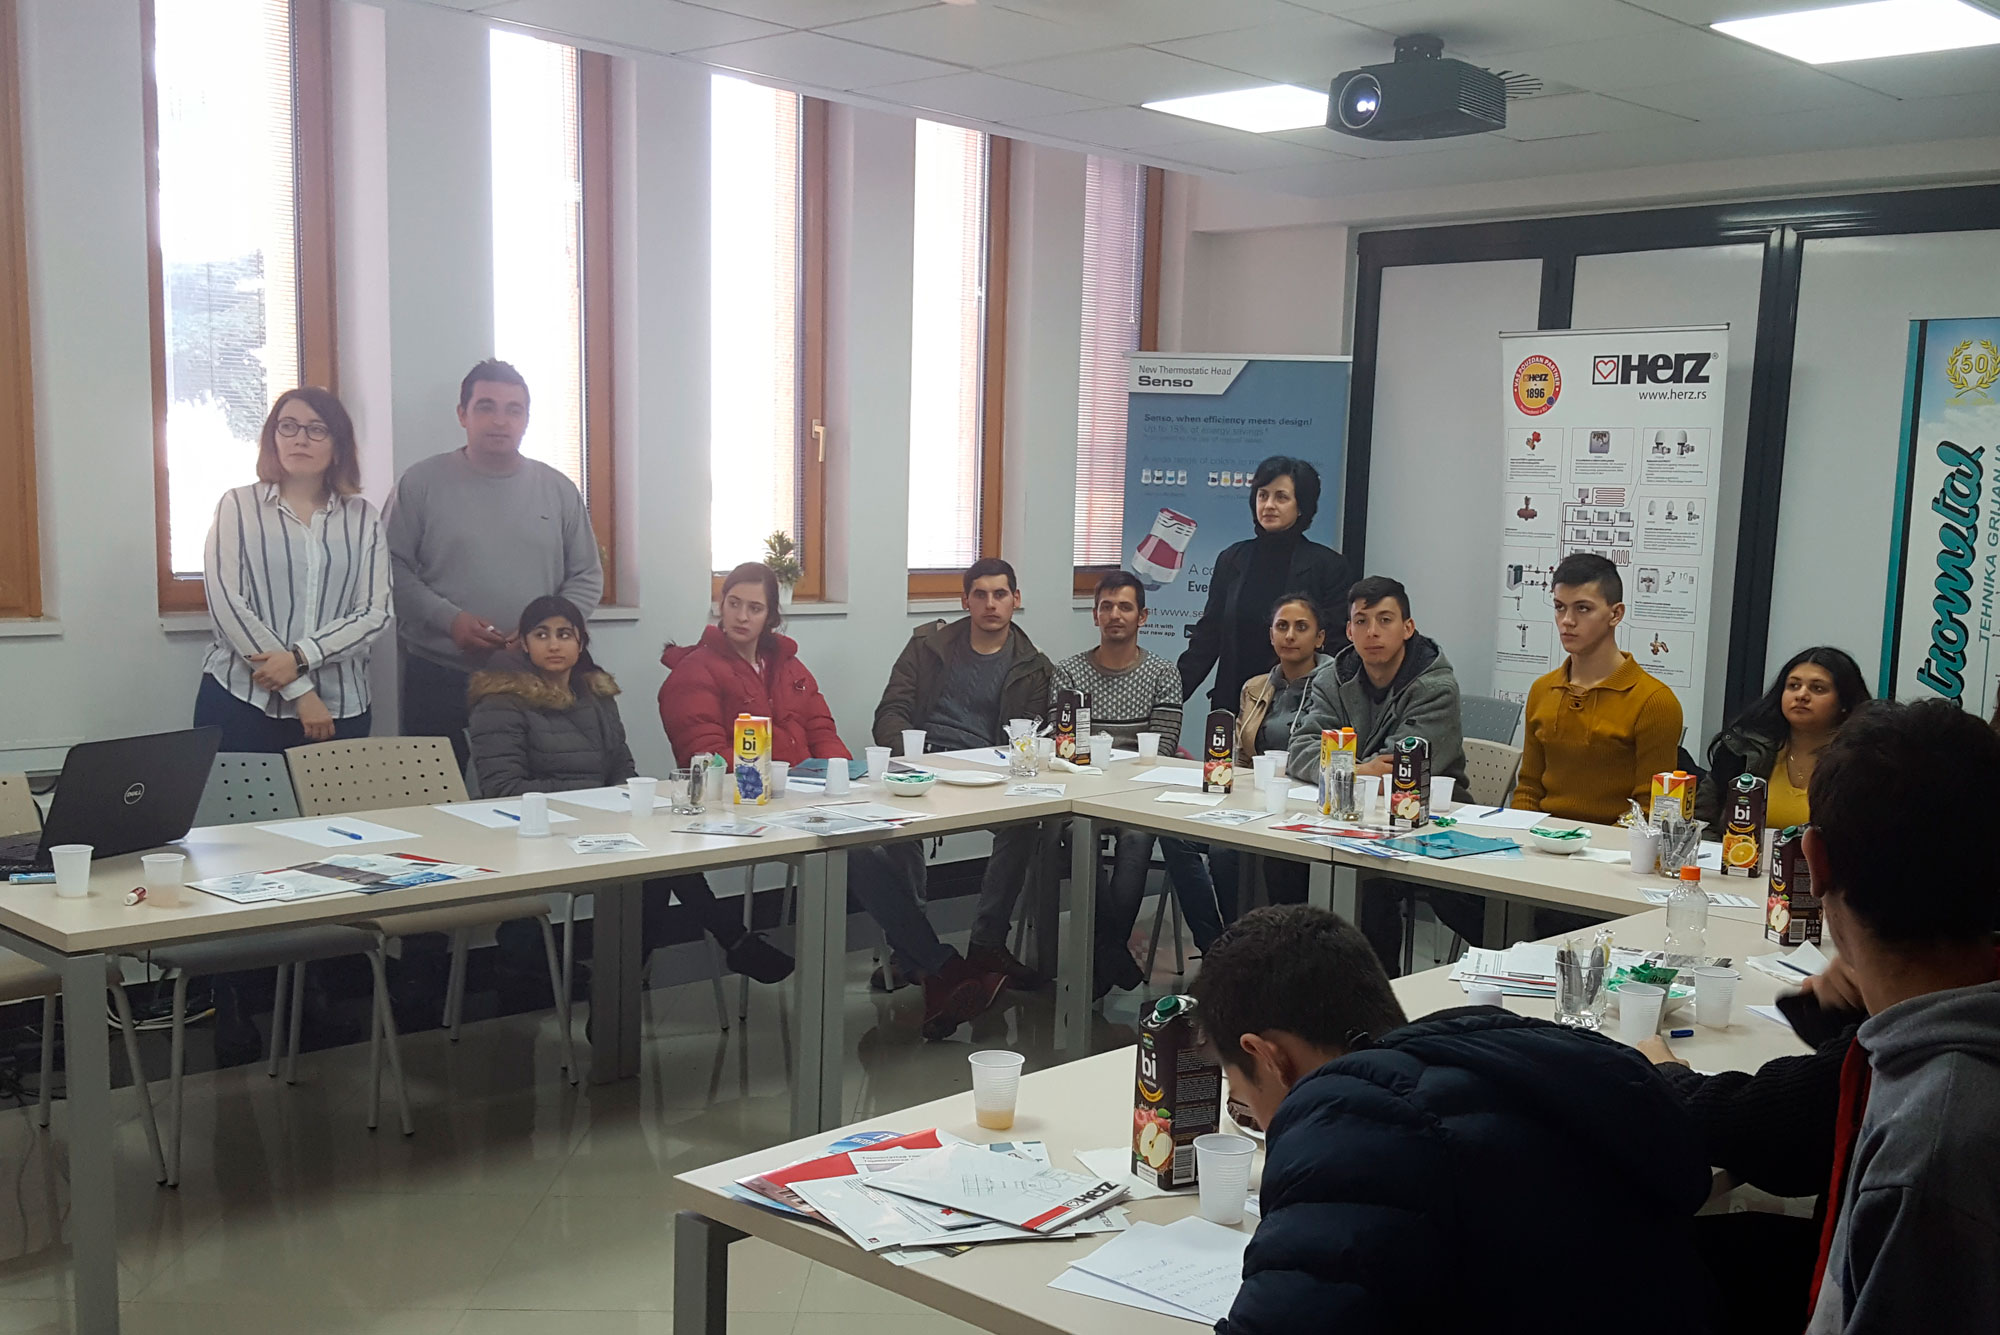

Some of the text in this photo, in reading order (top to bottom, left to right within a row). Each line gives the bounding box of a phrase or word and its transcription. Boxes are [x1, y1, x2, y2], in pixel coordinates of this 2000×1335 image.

[1139, 365, 1231, 375] New Thermostatic Head
[1960, 354, 1989, 374] 50
[1138, 375, 1193, 387] Senso
[1526, 388, 1545, 398] 1896
[1639, 389, 1707, 400] www.herz.rs
[1144, 413, 1313, 427] Senso, when efficiency meets design!
[1188, 564, 1198, 575] A
[1979, 554, 1997, 642] TEHNIKA
[1061, 710, 1071, 722] bi
[743, 737, 756, 751] bi
[1213, 734, 1226, 746] bi
[1399, 764, 1412, 777] bi
[1734, 805, 1750, 820] bi
[1772, 859, 1782, 877] bi
[1142, 1049, 1157, 1080] bi
